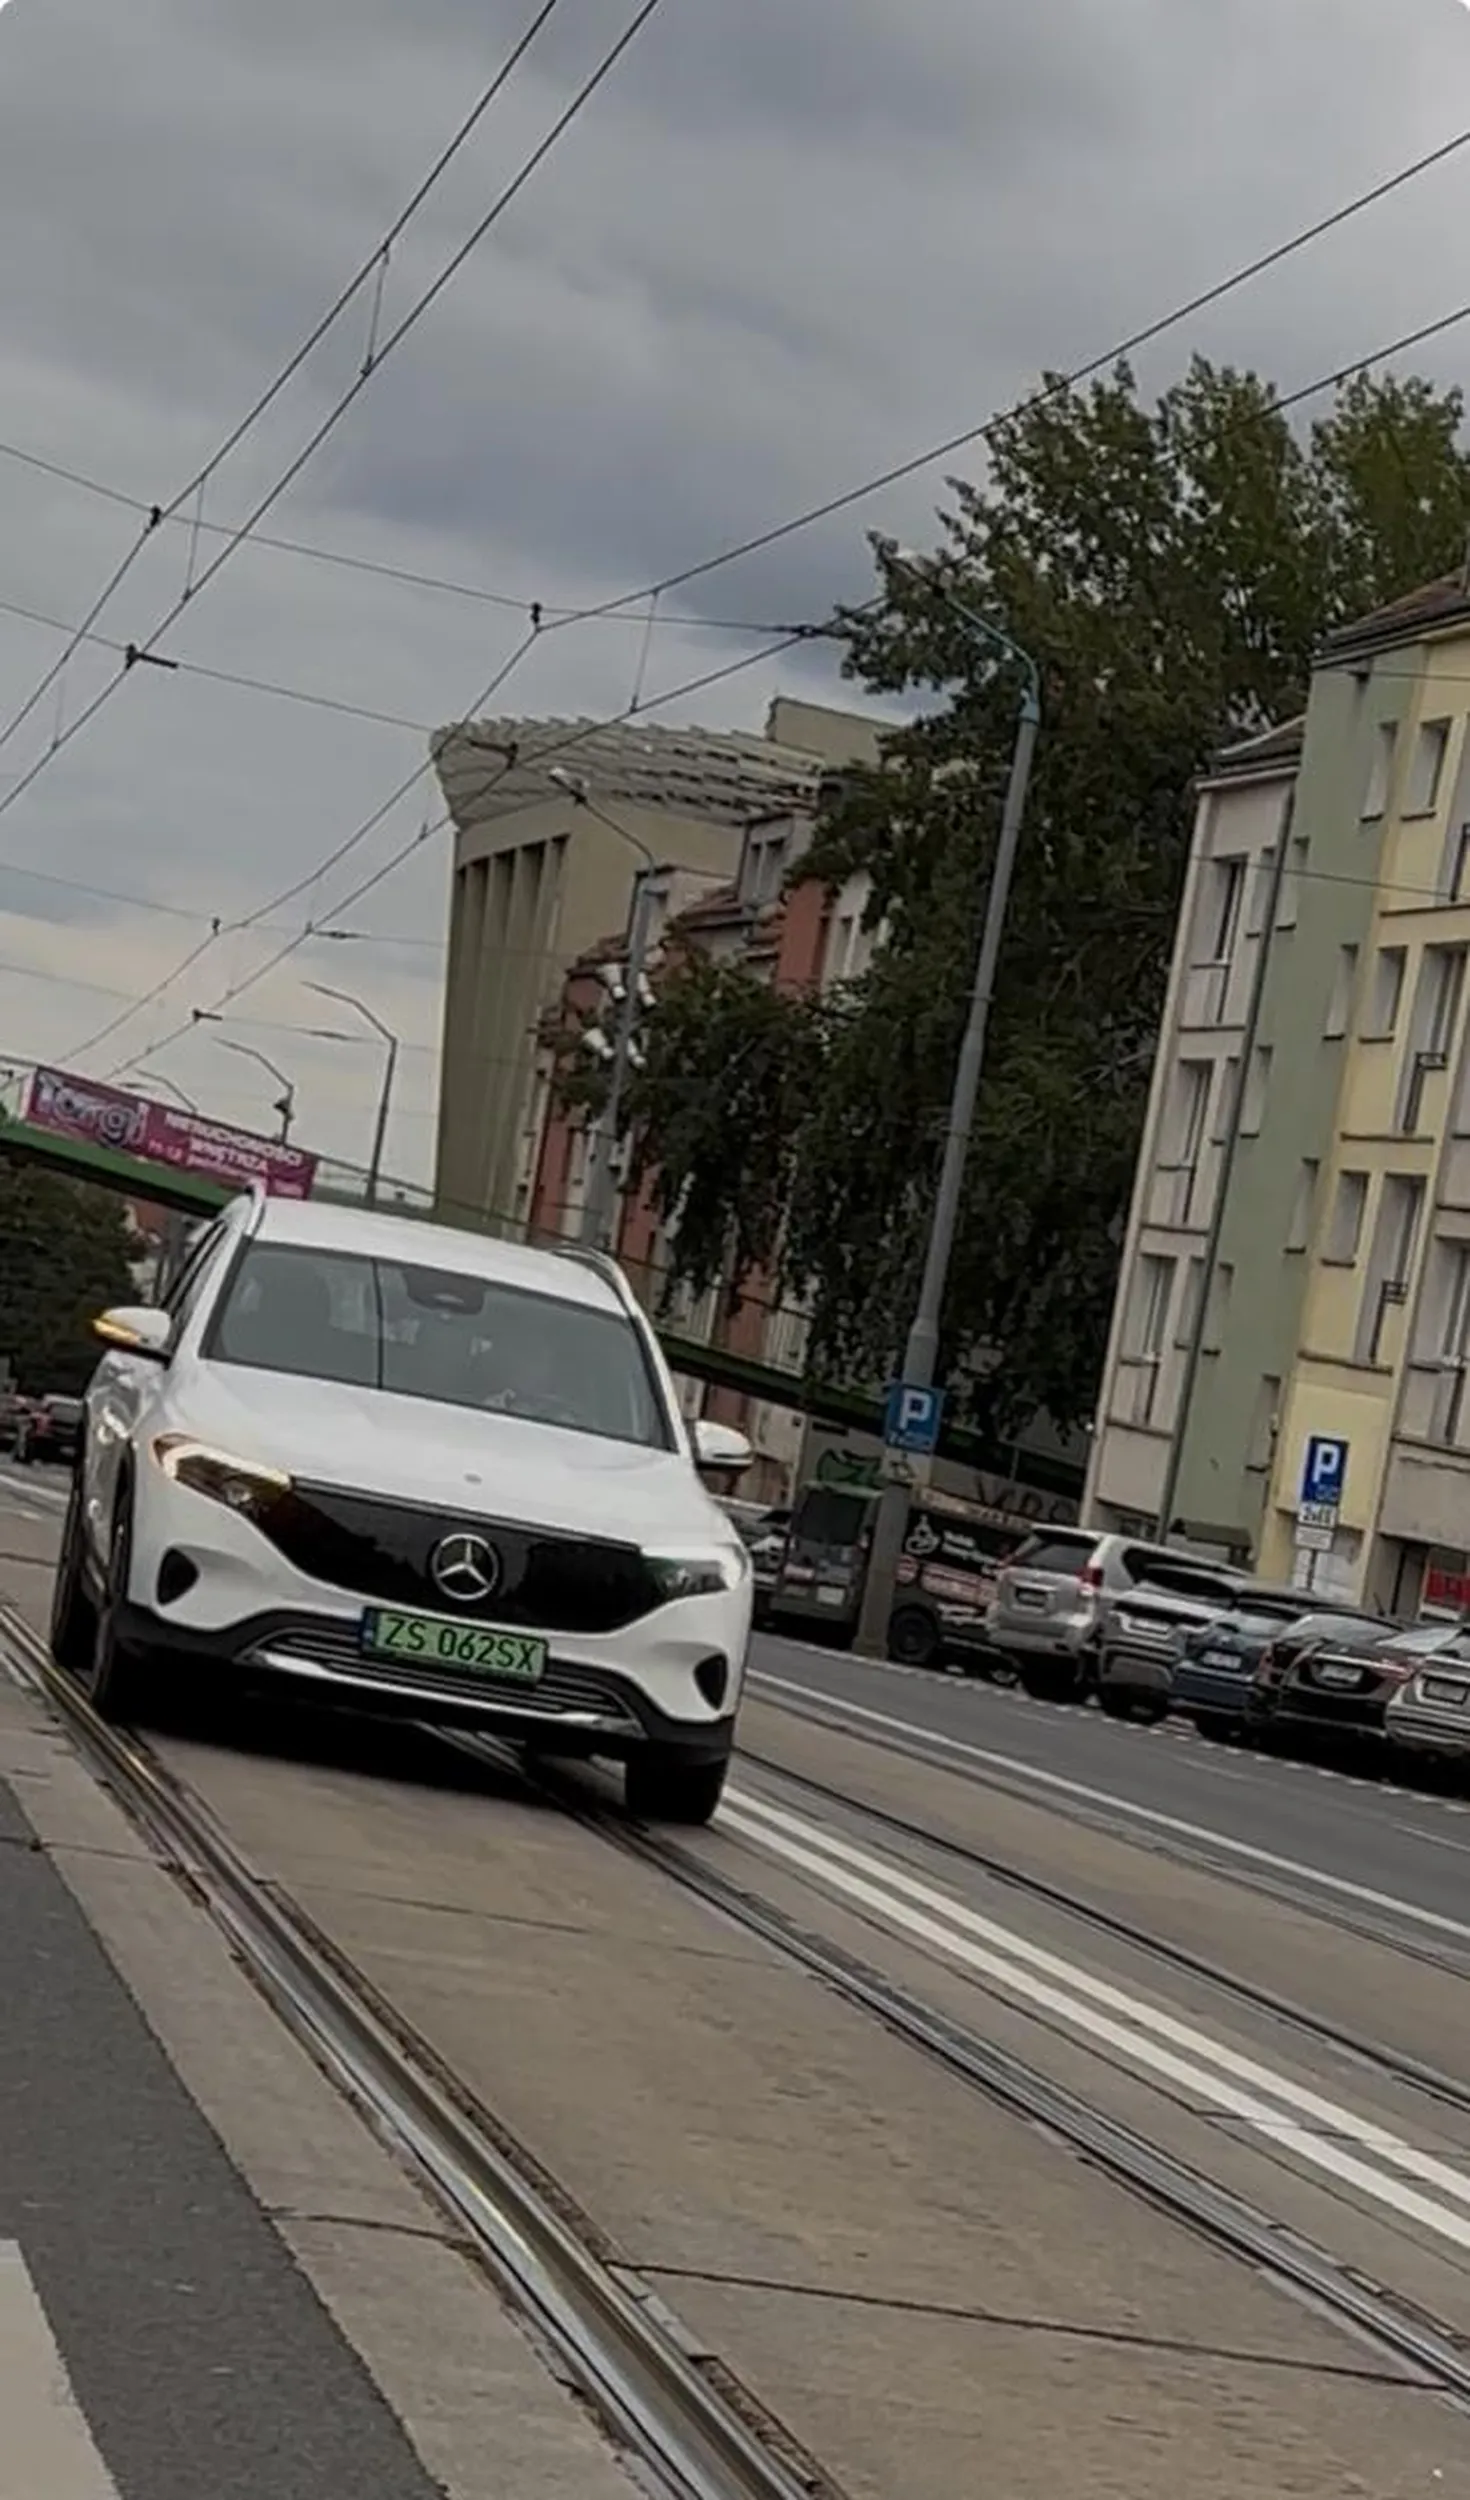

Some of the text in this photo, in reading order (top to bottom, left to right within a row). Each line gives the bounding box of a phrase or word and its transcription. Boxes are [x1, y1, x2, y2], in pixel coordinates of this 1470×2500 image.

[899, 1388, 932, 1430] P
[1312, 1443, 1340, 1483] P
[385, 1616, 538, 1672] ZS 062SX
